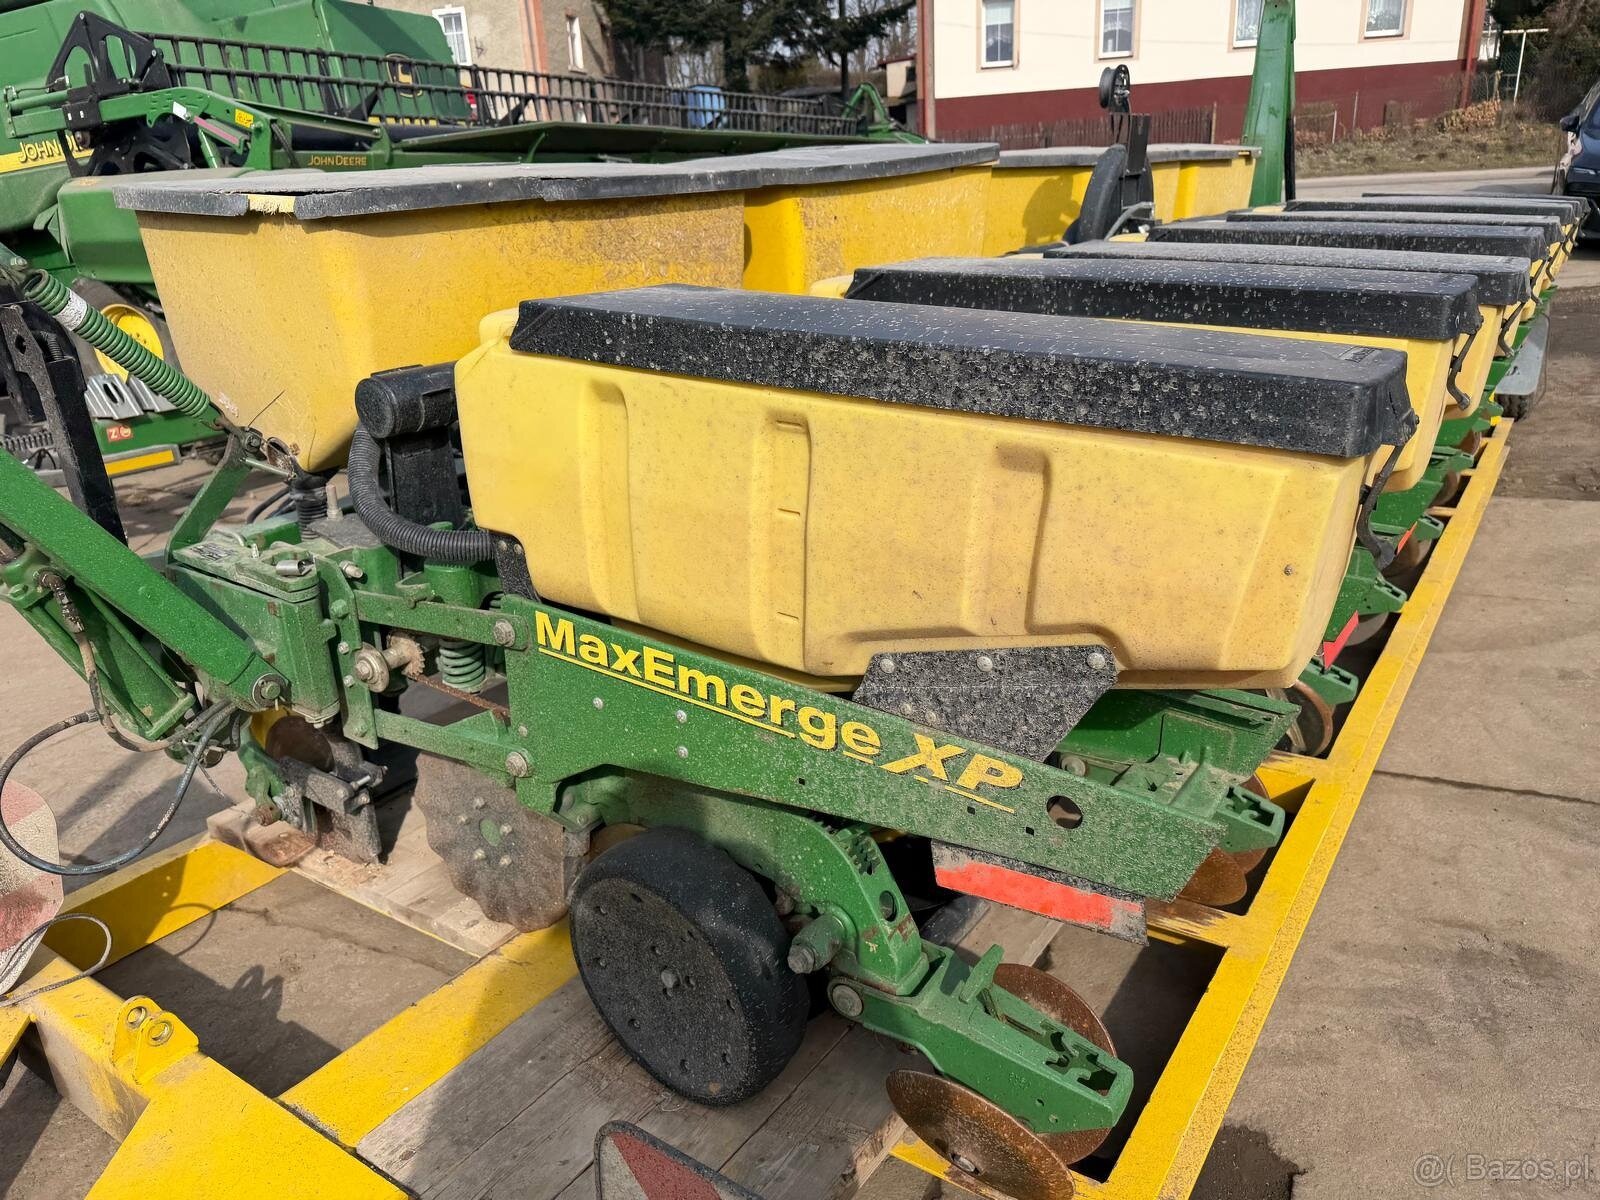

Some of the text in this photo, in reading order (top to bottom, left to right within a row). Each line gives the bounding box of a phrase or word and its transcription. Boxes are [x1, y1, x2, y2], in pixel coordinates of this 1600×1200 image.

[19, 138, 60, 164] JOHN
[308, 154, 367, 166] JOHN DEERE
[534, 610, 1024, 790] MaxEmerge XP
